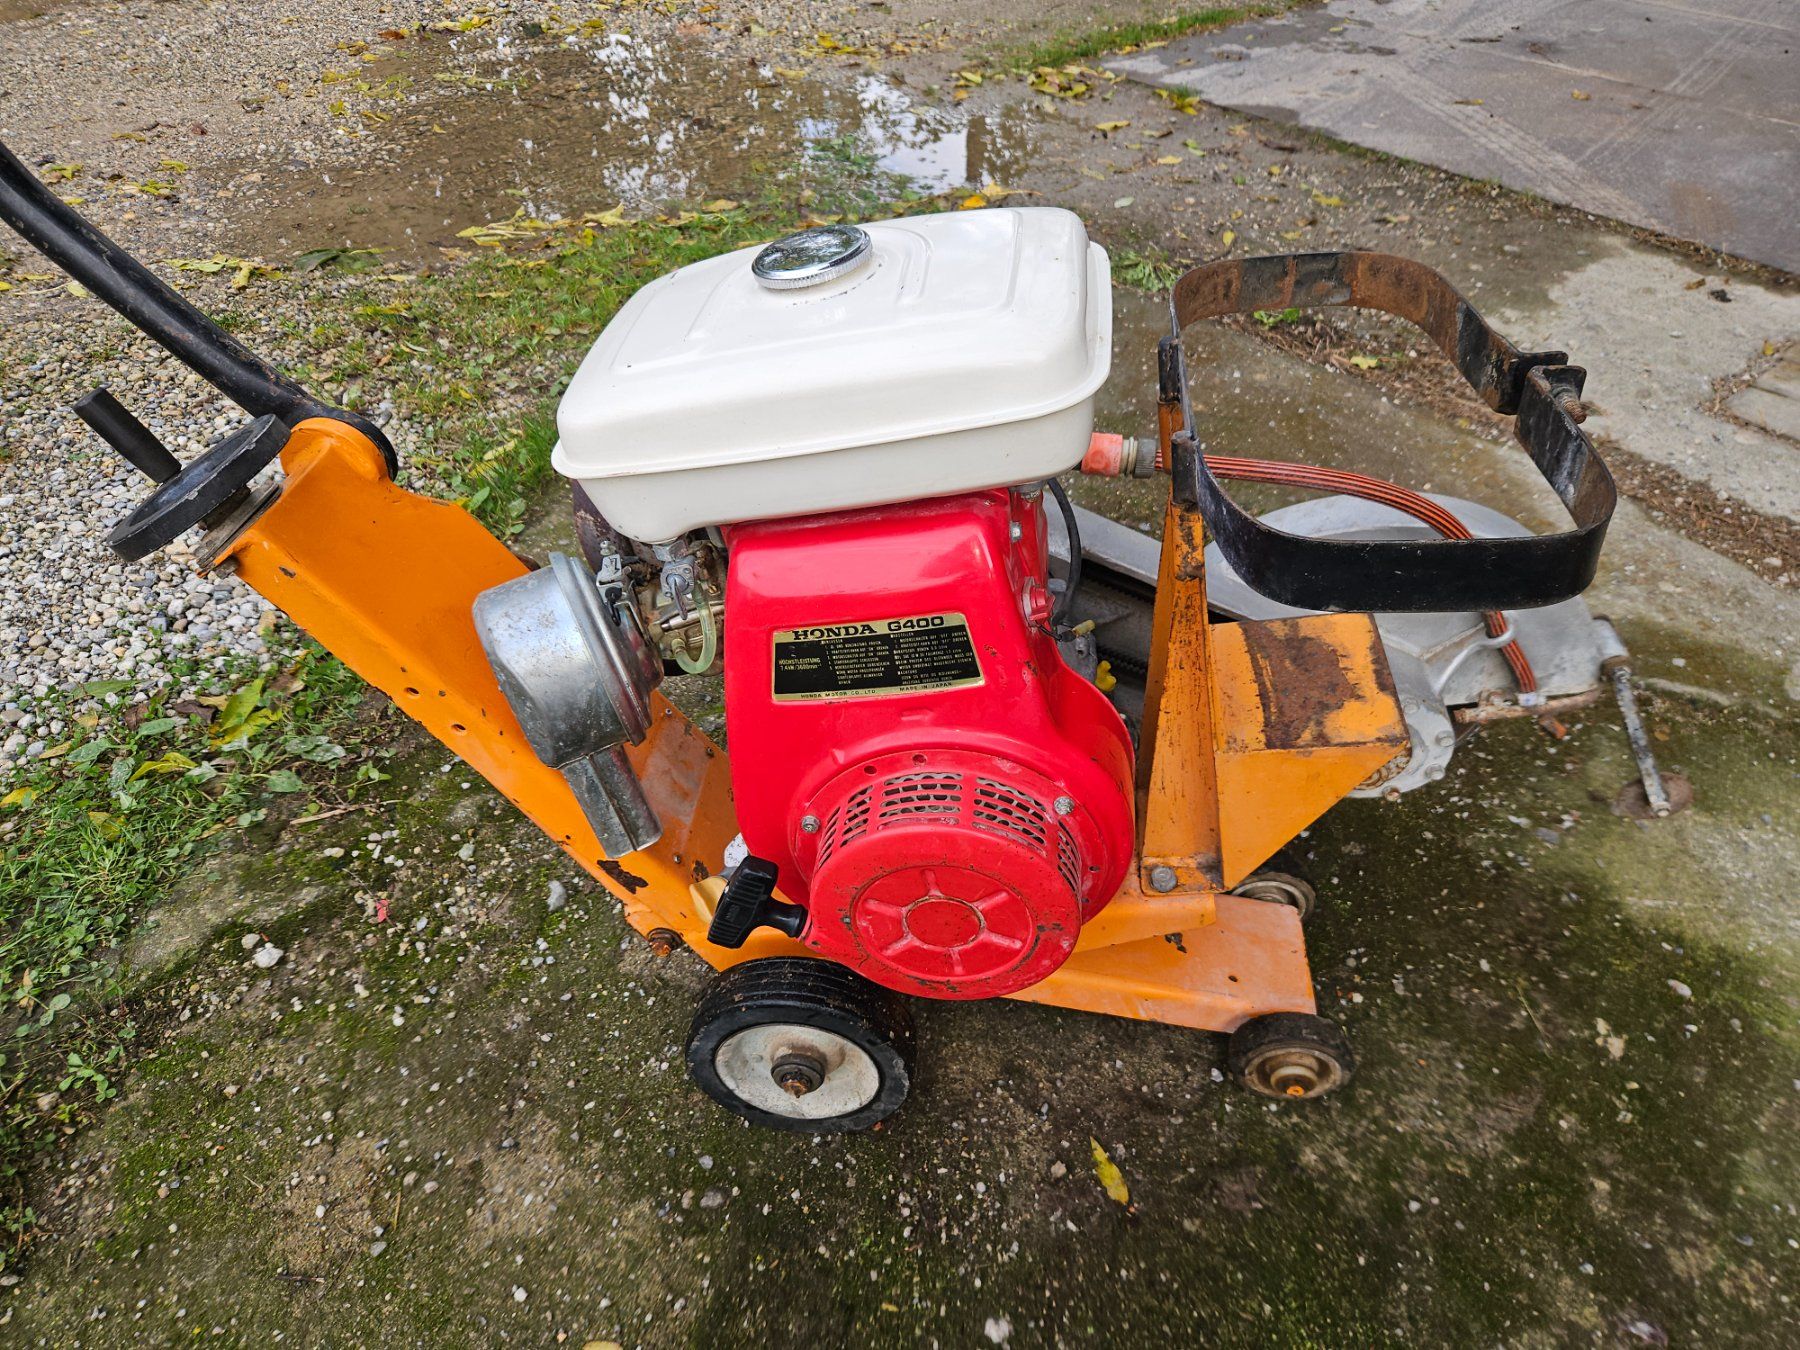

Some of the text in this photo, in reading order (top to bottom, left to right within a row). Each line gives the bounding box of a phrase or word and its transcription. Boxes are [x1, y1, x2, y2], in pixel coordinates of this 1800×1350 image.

[792, 624, 877, 640] HONDA
[887, 616, 945, 632] G400
[931, 681, 953, 689] JAPAN
